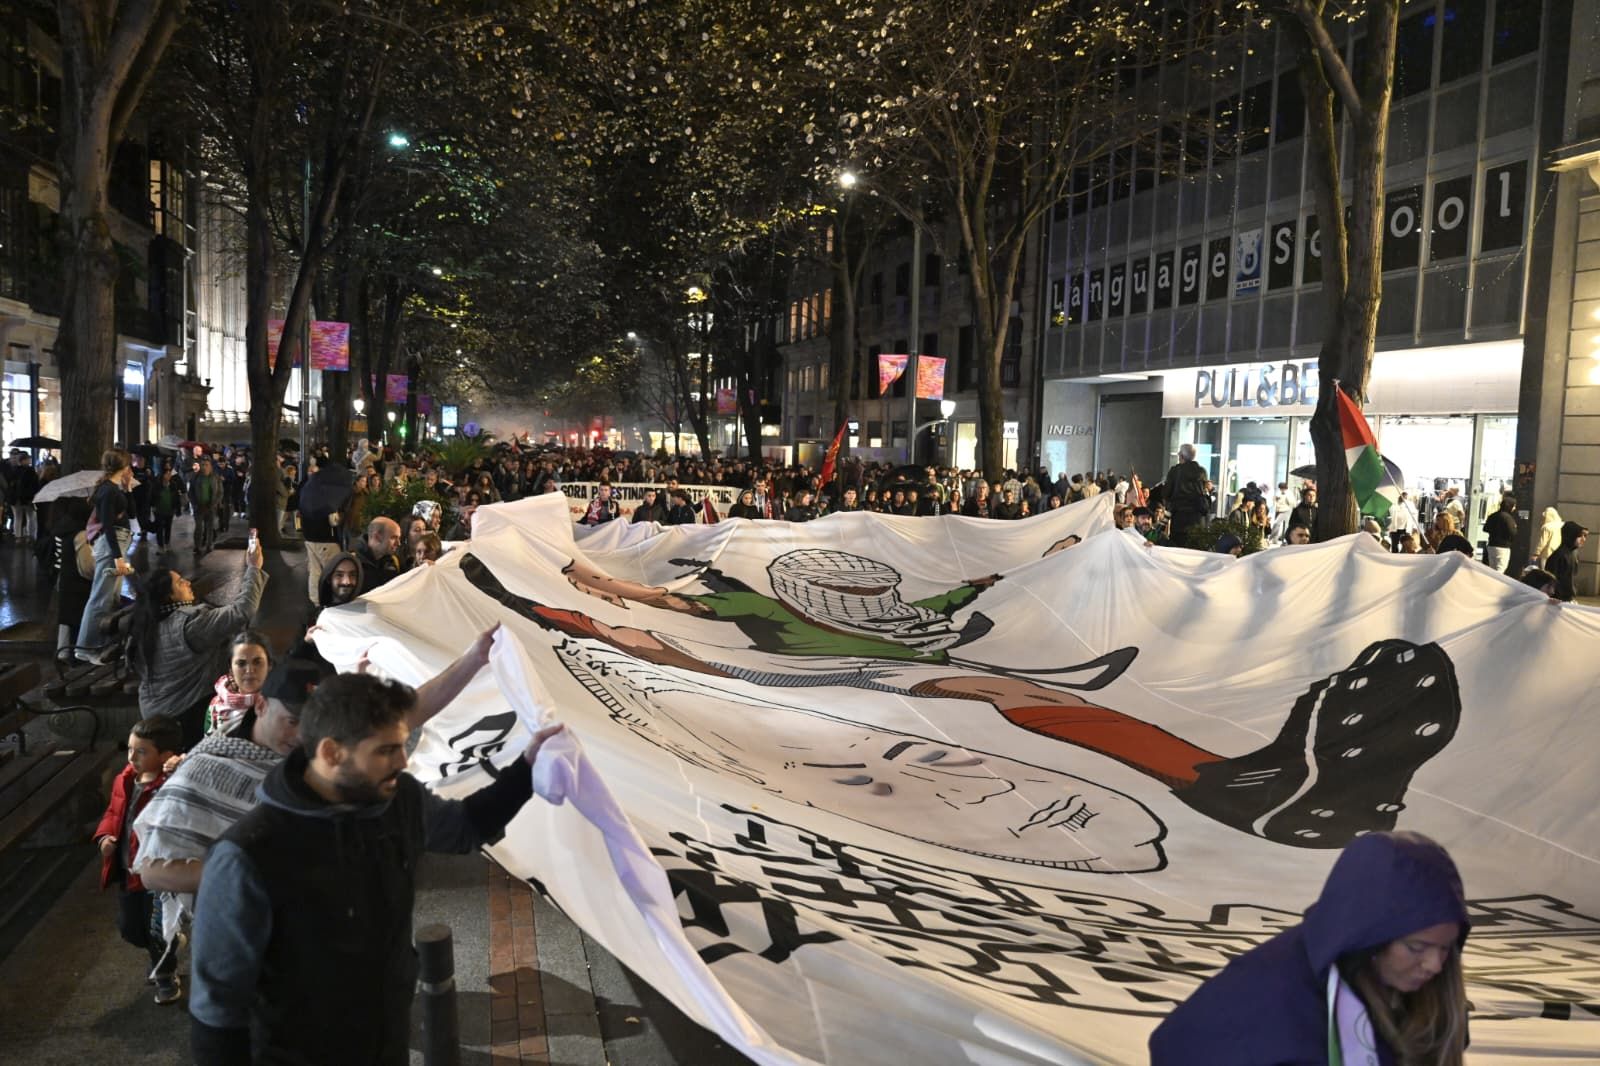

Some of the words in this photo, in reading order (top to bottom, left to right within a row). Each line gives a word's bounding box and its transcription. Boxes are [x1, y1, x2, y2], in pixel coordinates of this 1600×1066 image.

[1053, 251, 1226, 310] Language
[1275, 171, 1511, 265] Scool
[1195, 363, 1370, 408] PULL&BE
[1047, 424, 1094, 436] INBISA
